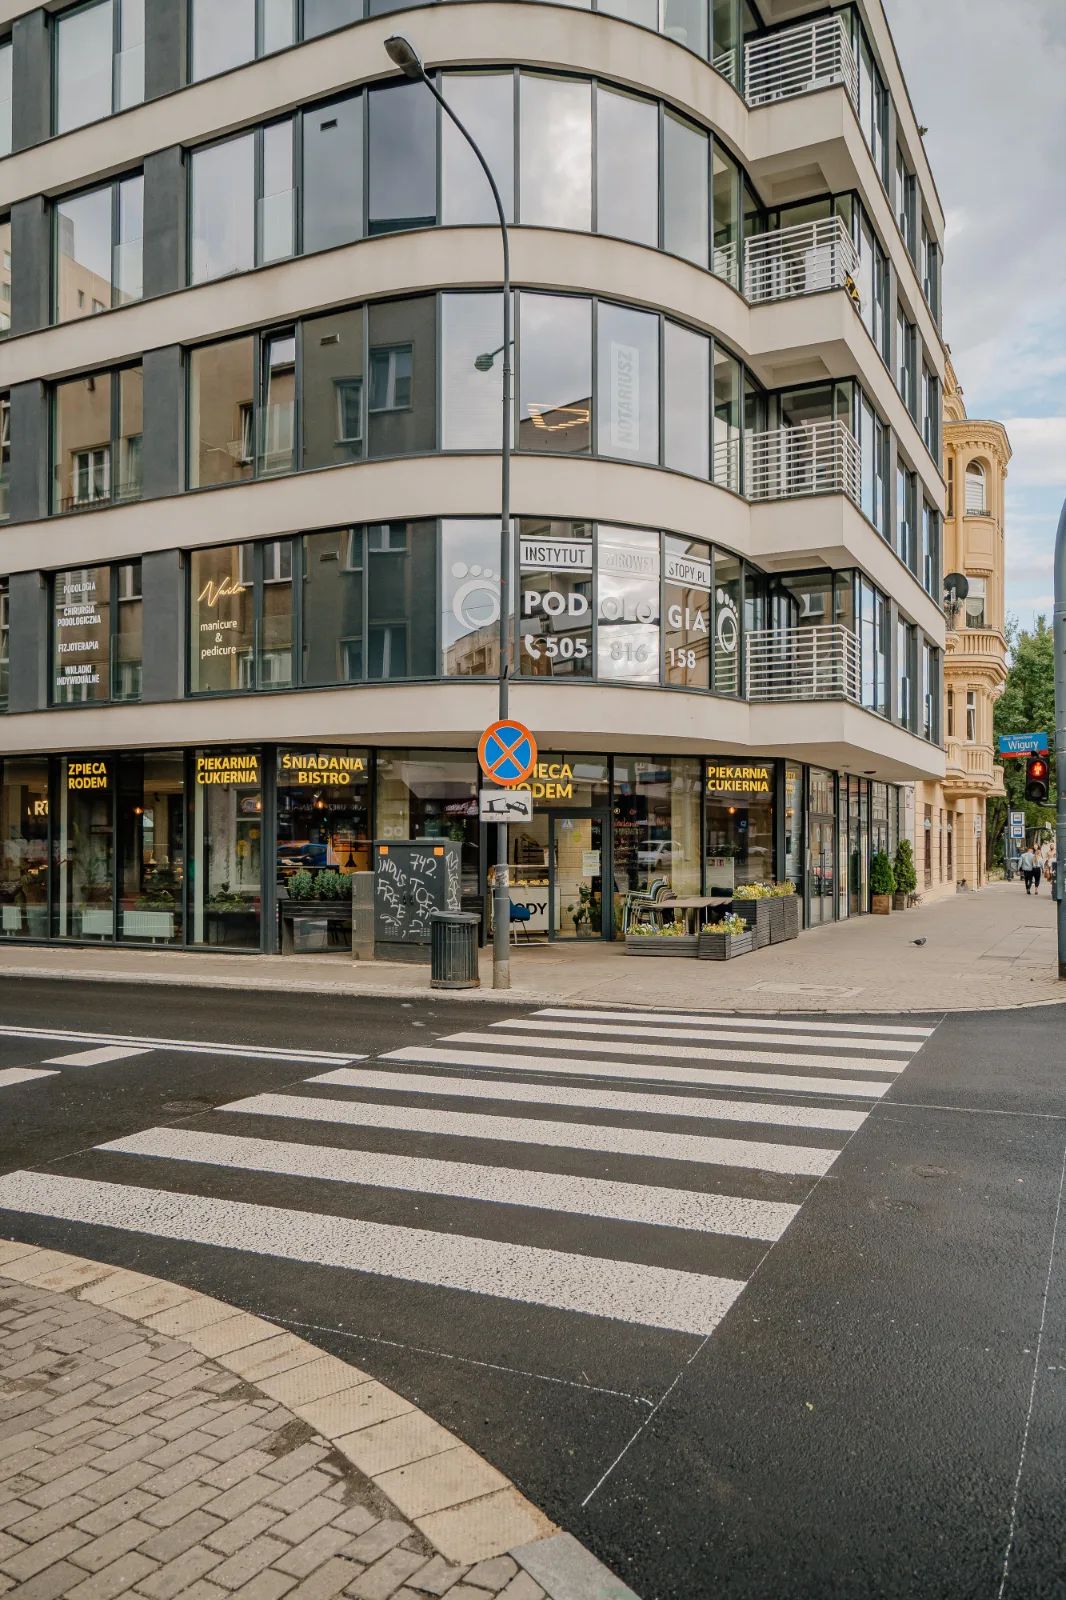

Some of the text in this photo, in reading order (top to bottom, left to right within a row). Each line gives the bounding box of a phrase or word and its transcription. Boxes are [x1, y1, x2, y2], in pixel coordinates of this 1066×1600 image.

[525, 546, 585, 564] INSTYTUT
[63, 582, 96, 594] PODOLOGIA
[63, 605, 95, 617] CHIRURGIA
[57, 615, 101, 628] PODOLOGICZNA
[200, 620, 238, 632] manicure
[215, 632, 223, 643] &
[58, 640, 99, 653] FIZJOTERAPIA
[201, 646, 237, 660] pedicure
[546, 638, 588, 659] 505
[668, 648, 696, 670] 158
[1007, 740, 1039, 751] Wigury
[197, 756, 258, 770] PIEKARNIA
[282, 753, 364, 771] ŚNIADANIA
[197, 771, 258, 784] CUKIERNIA
[531, 763, 573, 779] IECA
[707, 766, 768, 779] PIEKARNIA
[68, 777, 107, 789] RODEM
[298, 771, 350, 785] BISTRO
[707, 779, 769, 792] CUKIERNIA
